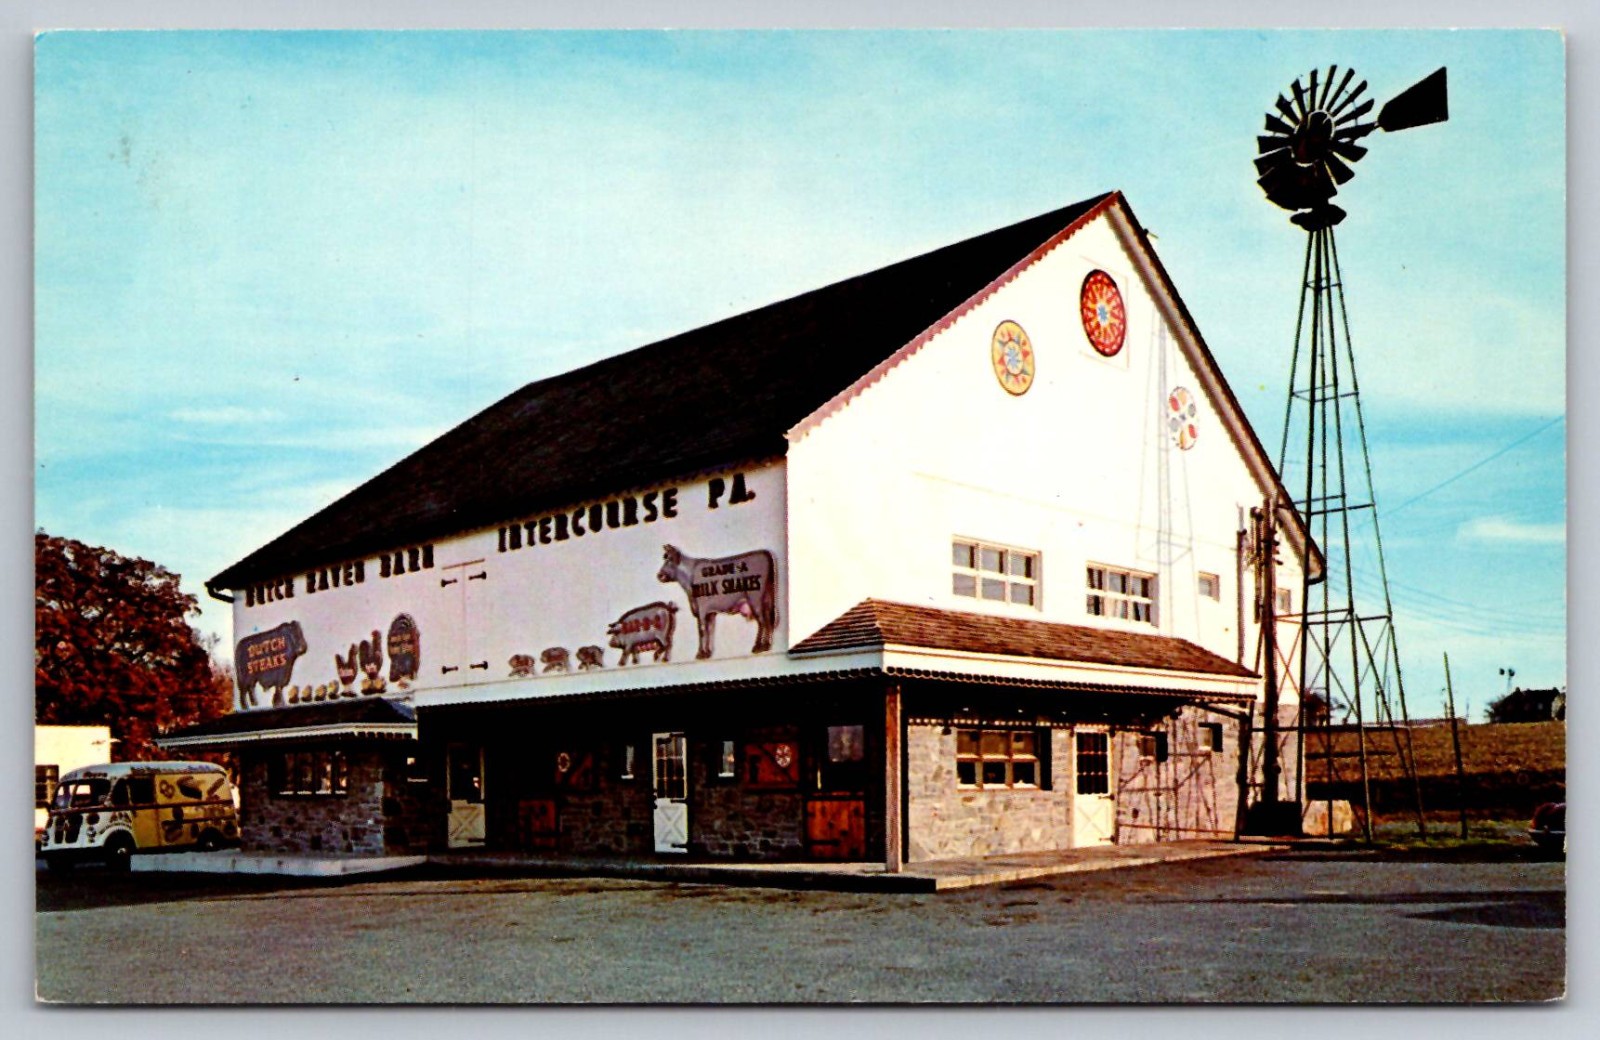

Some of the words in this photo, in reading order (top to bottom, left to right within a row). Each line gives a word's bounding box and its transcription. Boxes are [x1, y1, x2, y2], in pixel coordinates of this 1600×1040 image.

[497, 487, 679, 553] INTERCOURSE
[721, 574, 762, 595] SHAKES
[247, 636, 286, 659] DUTCH
[246, 653, 287, 674] STEAKS
